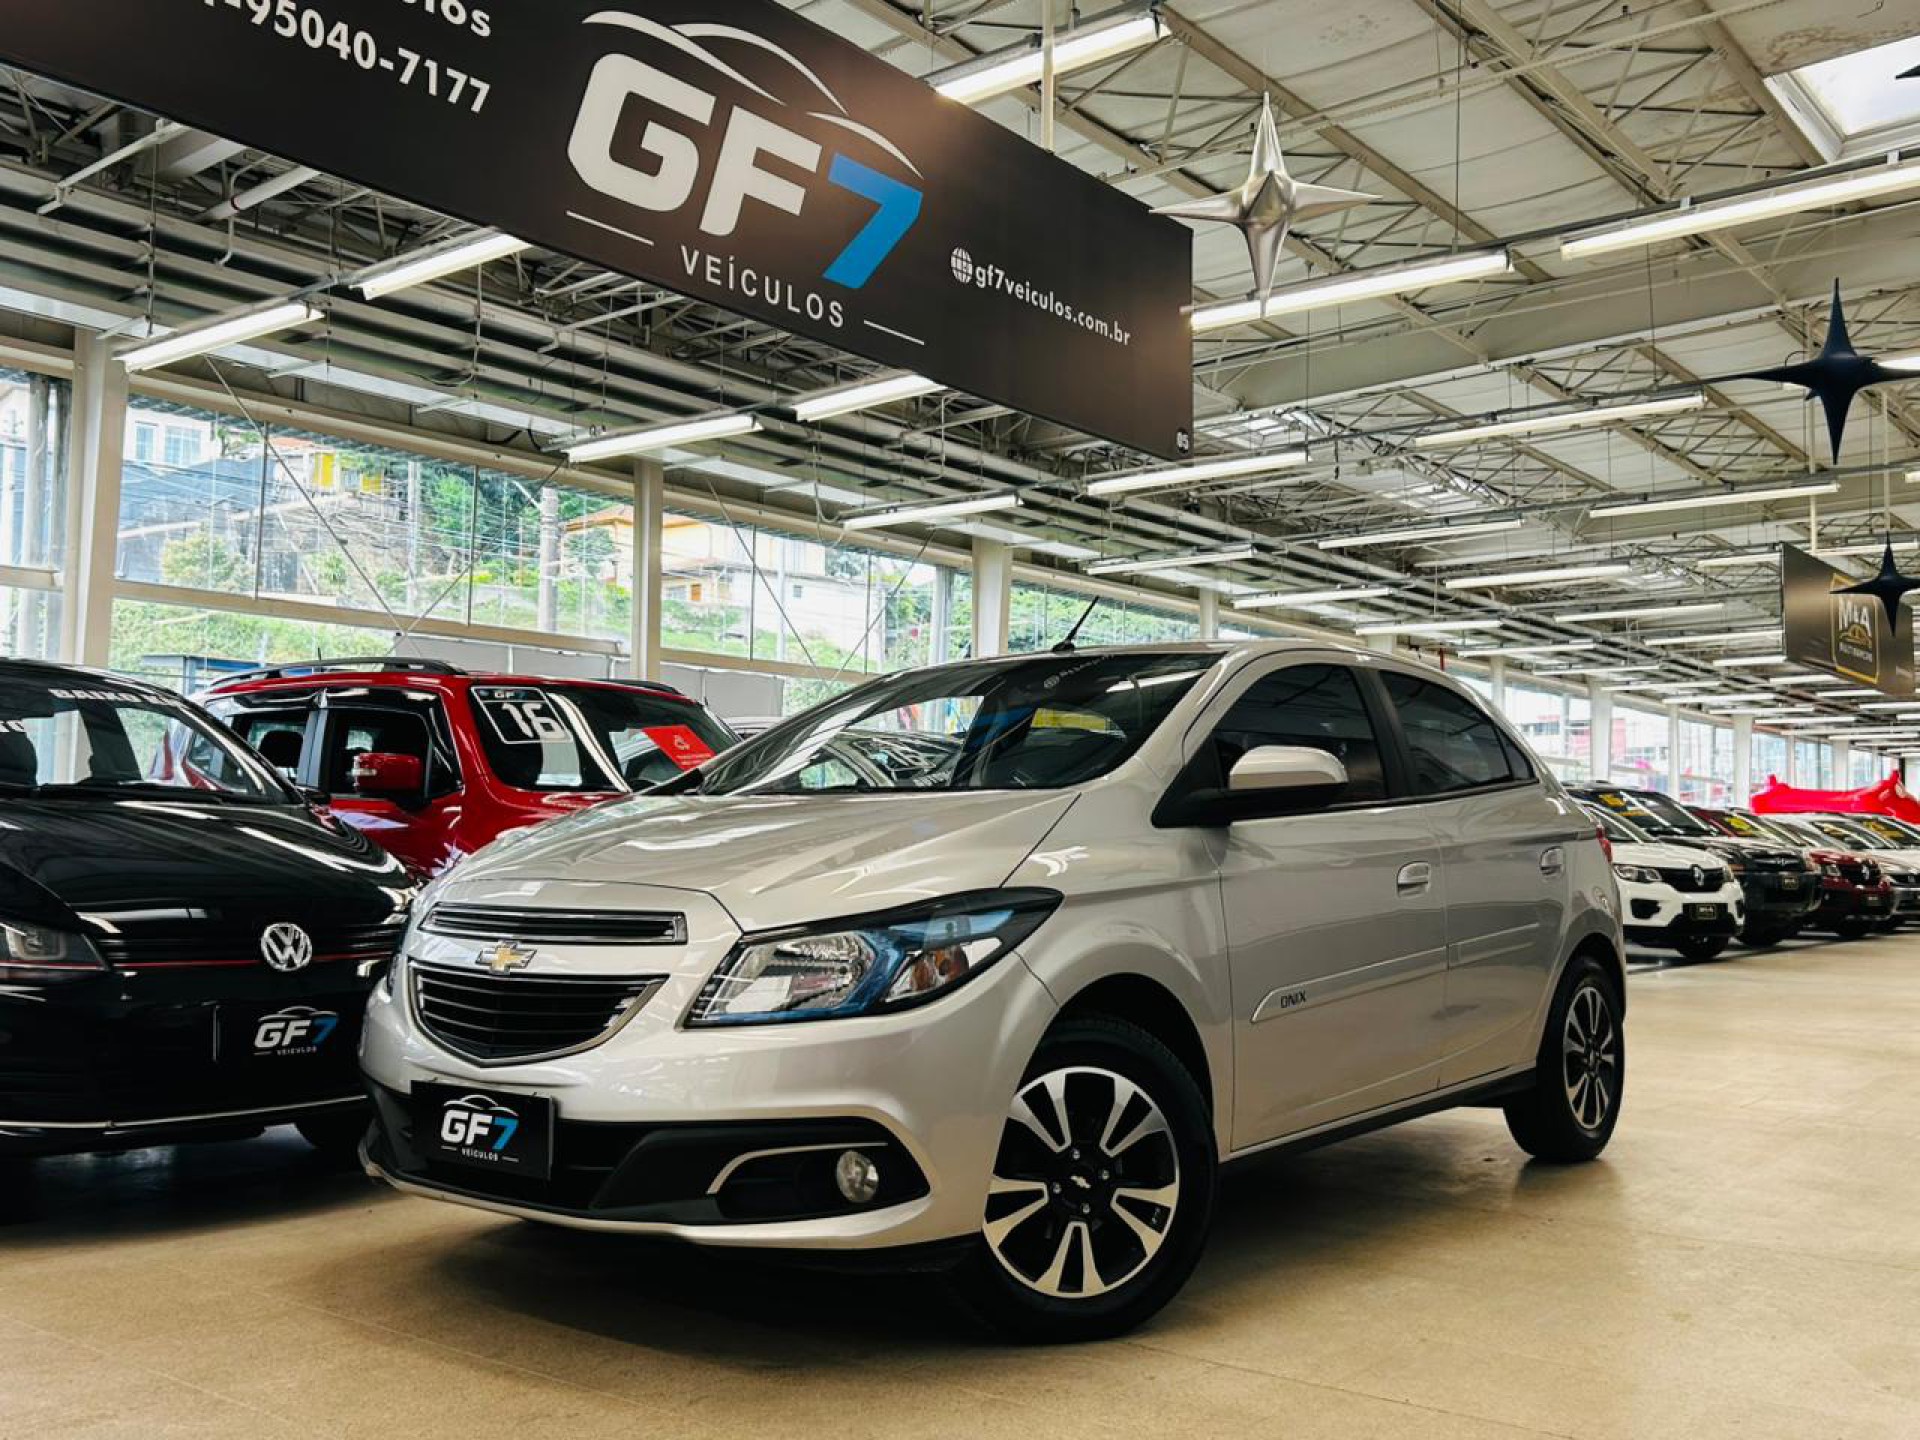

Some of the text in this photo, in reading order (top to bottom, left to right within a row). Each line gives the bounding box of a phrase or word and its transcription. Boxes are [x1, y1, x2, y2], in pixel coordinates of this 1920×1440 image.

[567, 53, 924, 289] GF7
[680, 245, 844, 328] VEÍCULOS
[975, 263, 1131, 345] gf7veiculos.com.br
[502, 702, 566, 739] 16
[1280, 990, 1306, 1009] ONIX
[254, 1016, 338, 1048] GF7
[441, 1109, 519, 1150] GF7
